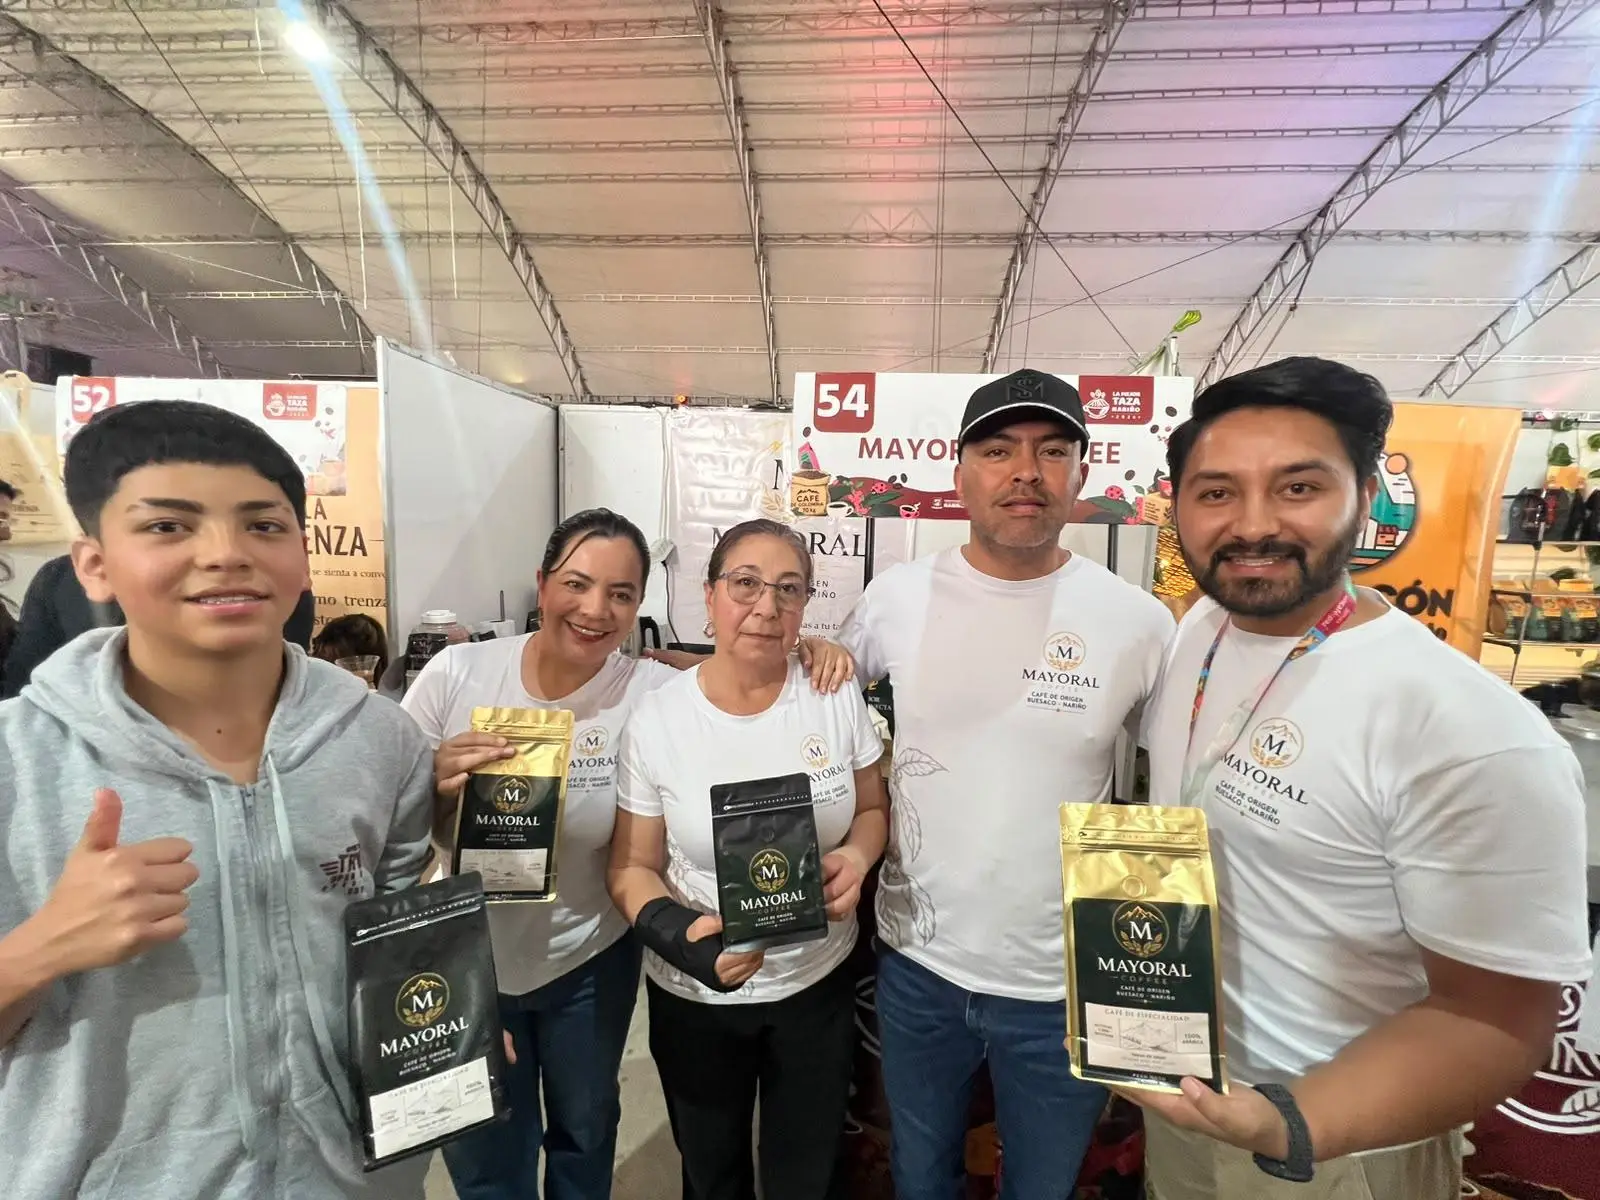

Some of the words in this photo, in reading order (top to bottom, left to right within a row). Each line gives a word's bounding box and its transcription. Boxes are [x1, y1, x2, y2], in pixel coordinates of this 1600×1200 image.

[73, 385, 111, 413] 52
[817, 383, 869, 418] 54
[1112, 397, 1141, 406] TAZA
[323, 568, 351, 577] sienta
[1055, 645, 1073, 660] M
[1022, 668, 1100, 689] MAYORAL
[1027, 697, 1057, 706] BUESACO
[1062, 701, 1087, 710] NARIÑO
[1060, 695, 1084, 703] ORIGEN
[585, 735, 599, 747] M
[809, 745, 823, 757] M
[1261, 733, 1286, 756] M
[1222, 753, 1309, 805] MAYORAL
[503, 787, 520, 802] M
[1236, 790, 1246, 800] DE
[1247, 796, 1278, 816] ORIGEN
[475, 813, 541, 826] MAYORAL
[1248, 806, 1281, 826] NARIÑO
[761, 864, 779, 881] M
[740, 889, 807, 911] MAYORAL
[1130, 920, 1153, 941] M
[1097, 956, 1193, 978] MAYORAL
[411, 990, 434, 1013] M
[379, 1016, 470, 1058] MAYORAL
